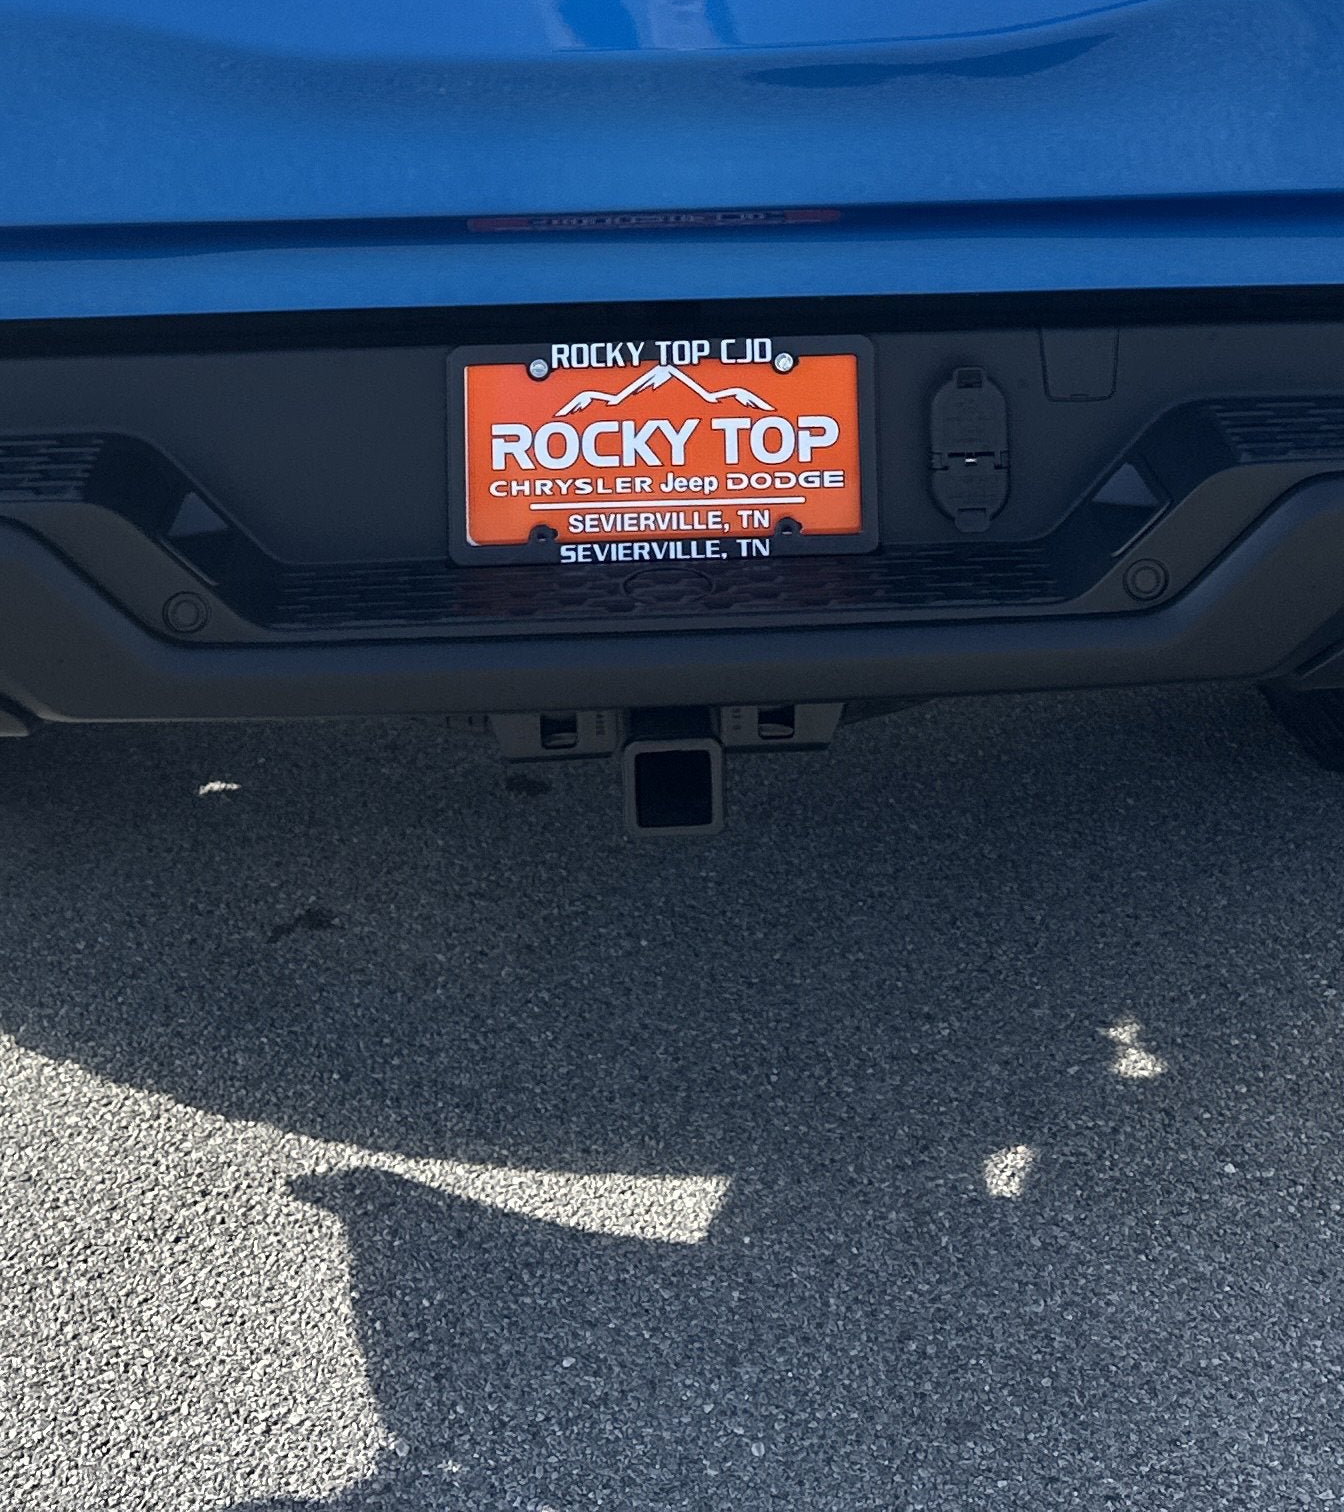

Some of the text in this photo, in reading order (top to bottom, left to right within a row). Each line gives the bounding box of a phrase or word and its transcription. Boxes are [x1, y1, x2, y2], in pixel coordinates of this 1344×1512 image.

[551, 337, 773, 369] ROCKY TOP CJD
[490, 415, 840, 471] ROCKY TOP
[488, 470, 845, 497] CHRYSLER Jeep DODGE
[568, 508, 771, 534] SEVIERVILLE, TN
[559, 538, 771, 564] SEVIERVILLE, TN
